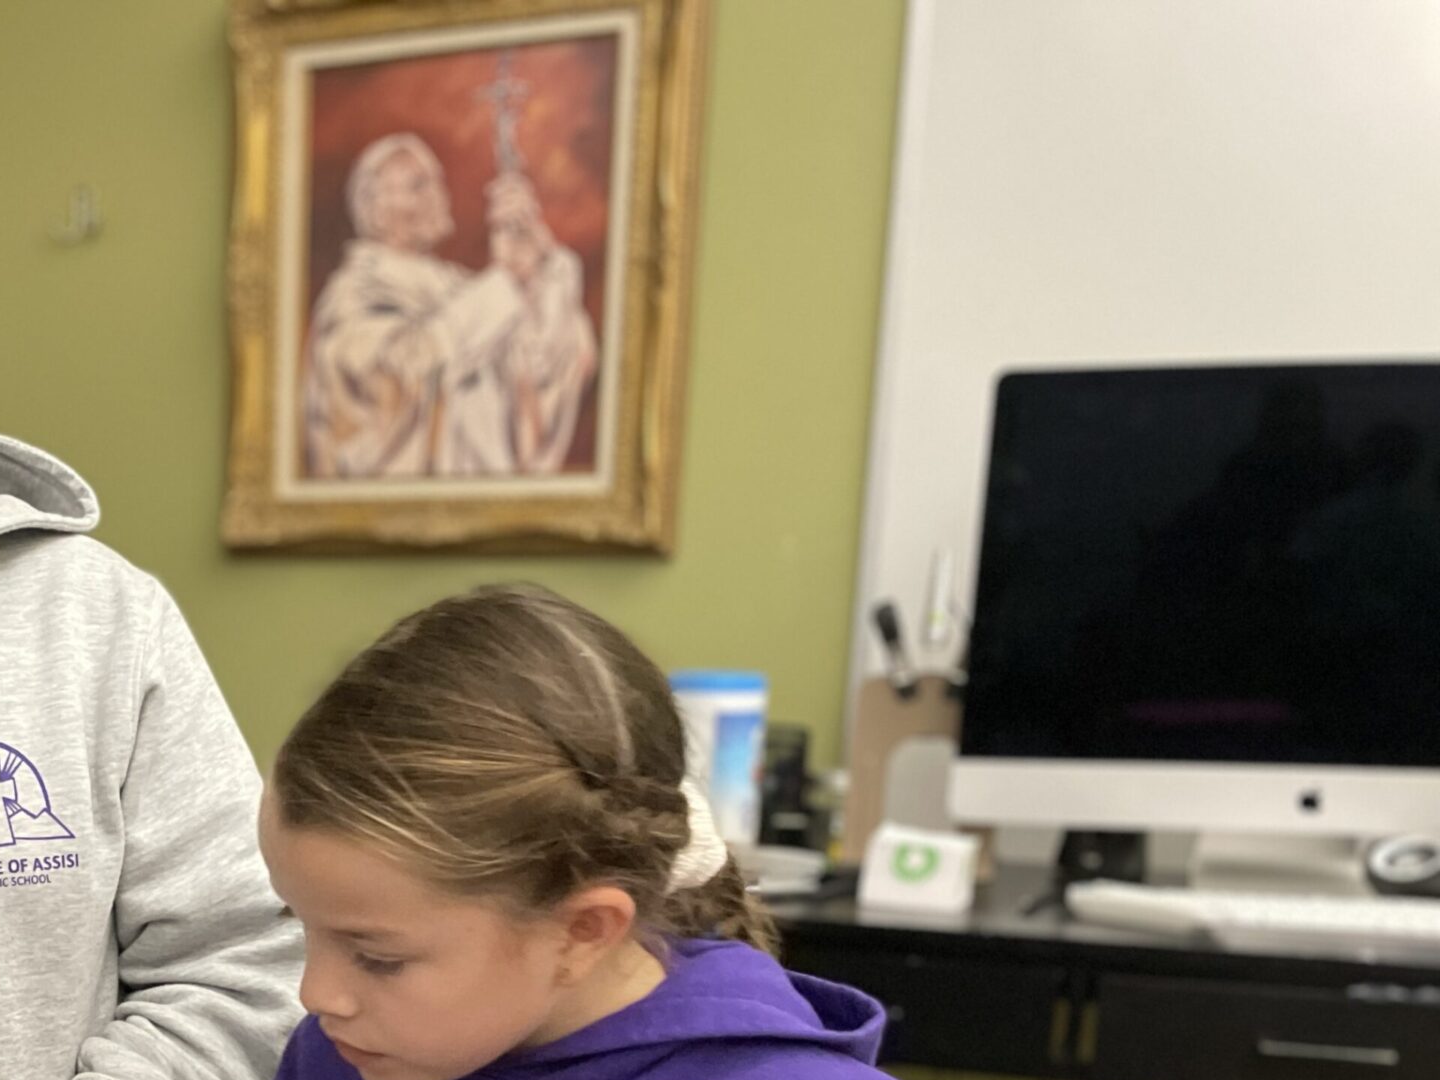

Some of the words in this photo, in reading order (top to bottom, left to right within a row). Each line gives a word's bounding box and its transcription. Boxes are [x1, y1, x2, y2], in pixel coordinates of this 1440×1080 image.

[8, 858, 29, 874] OF
[32, 853, 80, 872] ASSISI
[10, 873, 52, 887] SCHOOL
